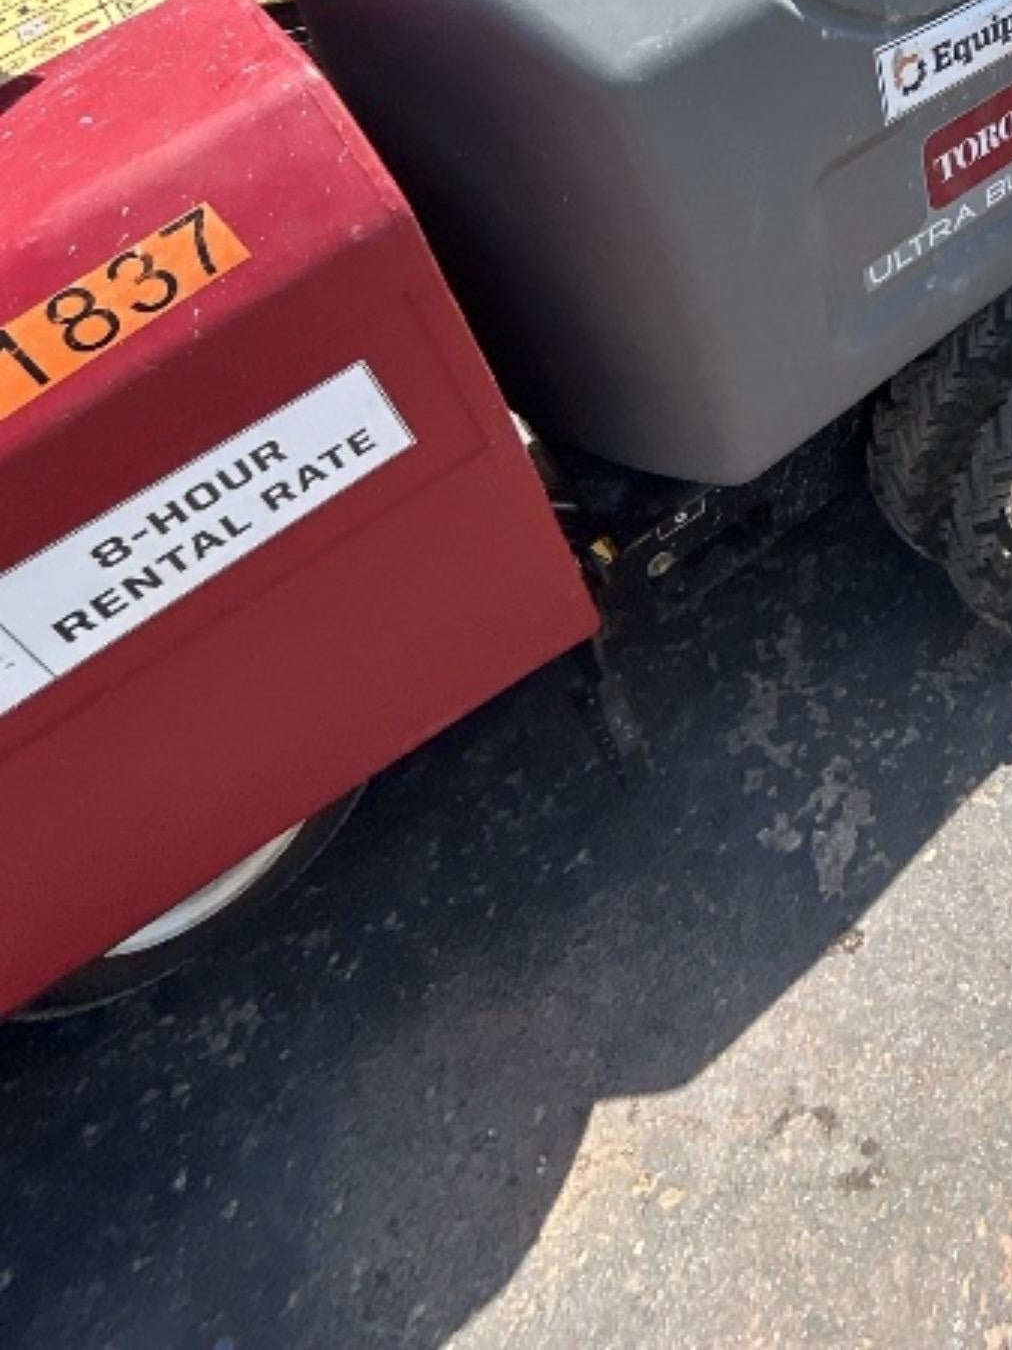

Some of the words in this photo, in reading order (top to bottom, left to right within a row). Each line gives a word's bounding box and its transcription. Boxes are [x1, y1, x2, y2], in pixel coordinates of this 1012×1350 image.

[0, 207, 218, 386] 1837
[868, 204, 976, 284] ULTRA
[52, 517, 253, 643] RENTAL
[260, 427, 378, 514] RATE
[90, 439, 289, 568] 8-HOUR
